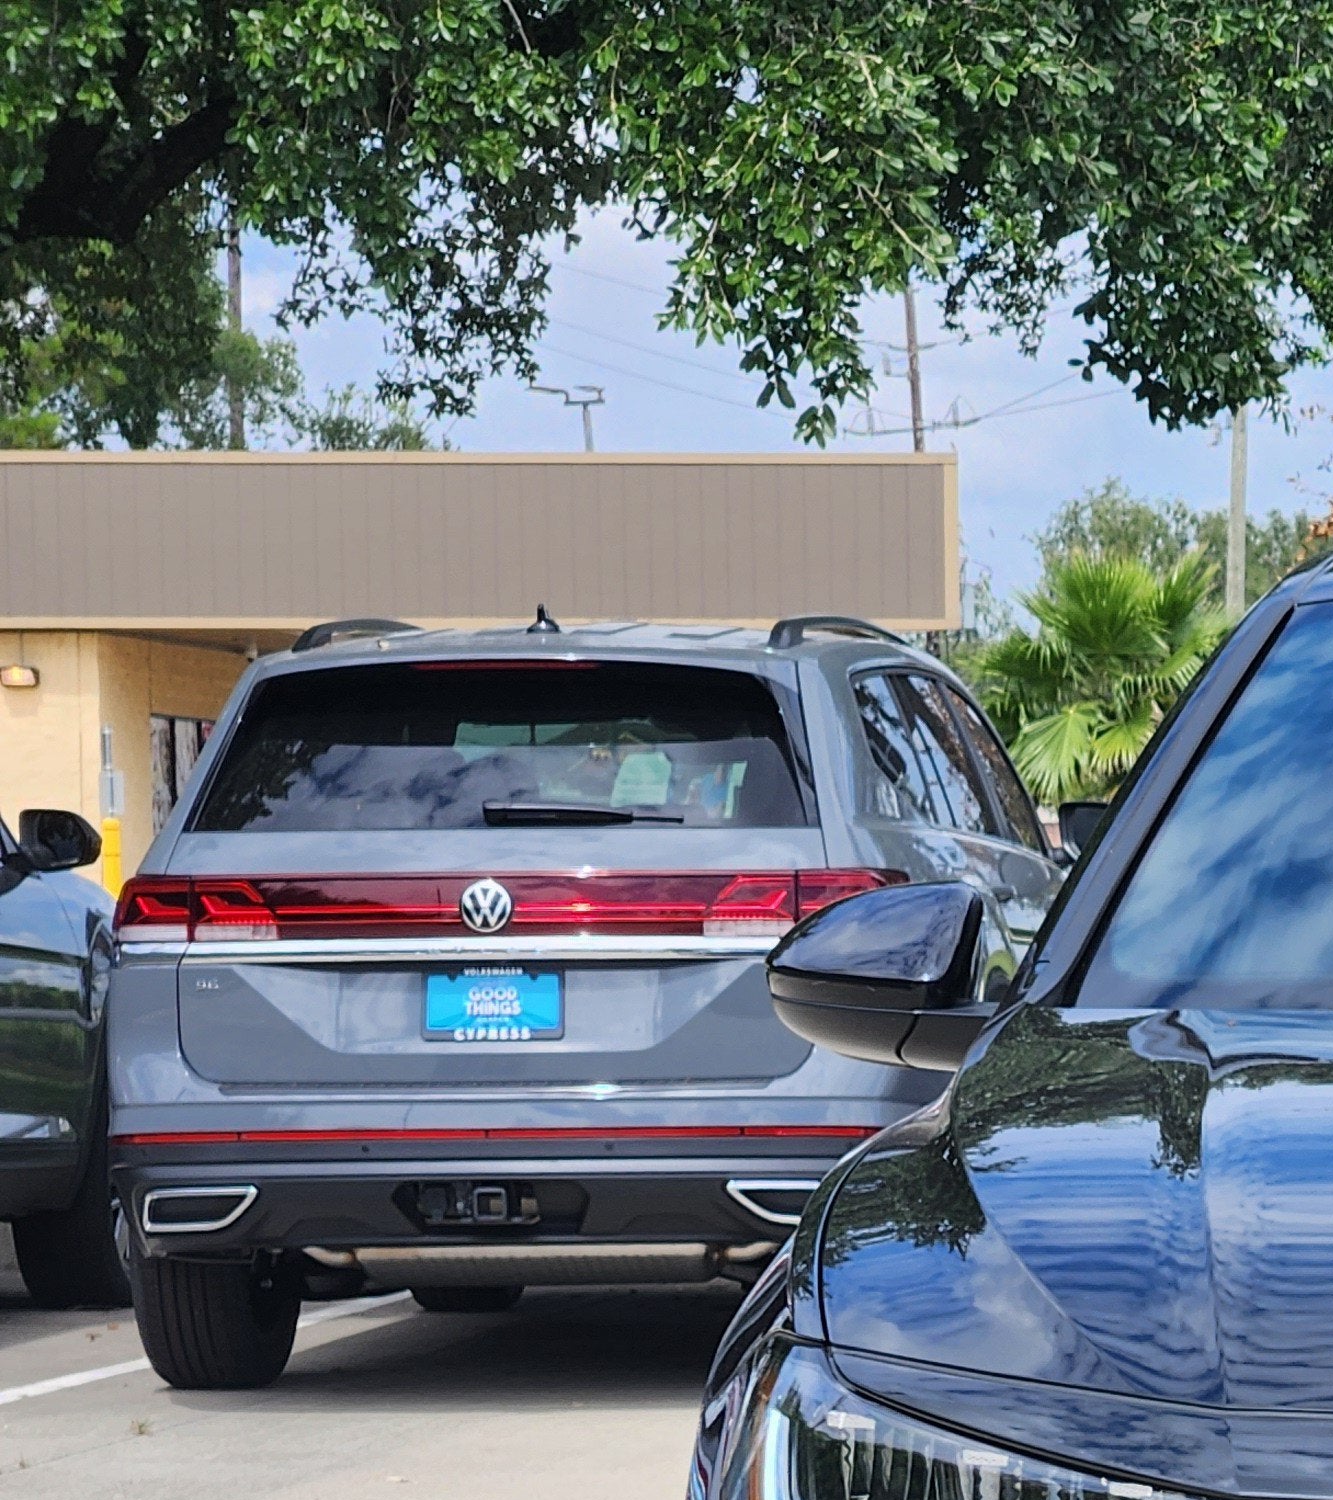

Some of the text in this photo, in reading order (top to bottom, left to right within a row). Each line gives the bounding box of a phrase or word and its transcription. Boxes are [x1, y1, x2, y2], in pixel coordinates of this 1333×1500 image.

[461, 878, 512, 932] VW
[469, 986, 518, 1001] GOOD
[466, 1000, 522, 1015] THINGS
[453, 1026, 531, 1041] CYPRESS
